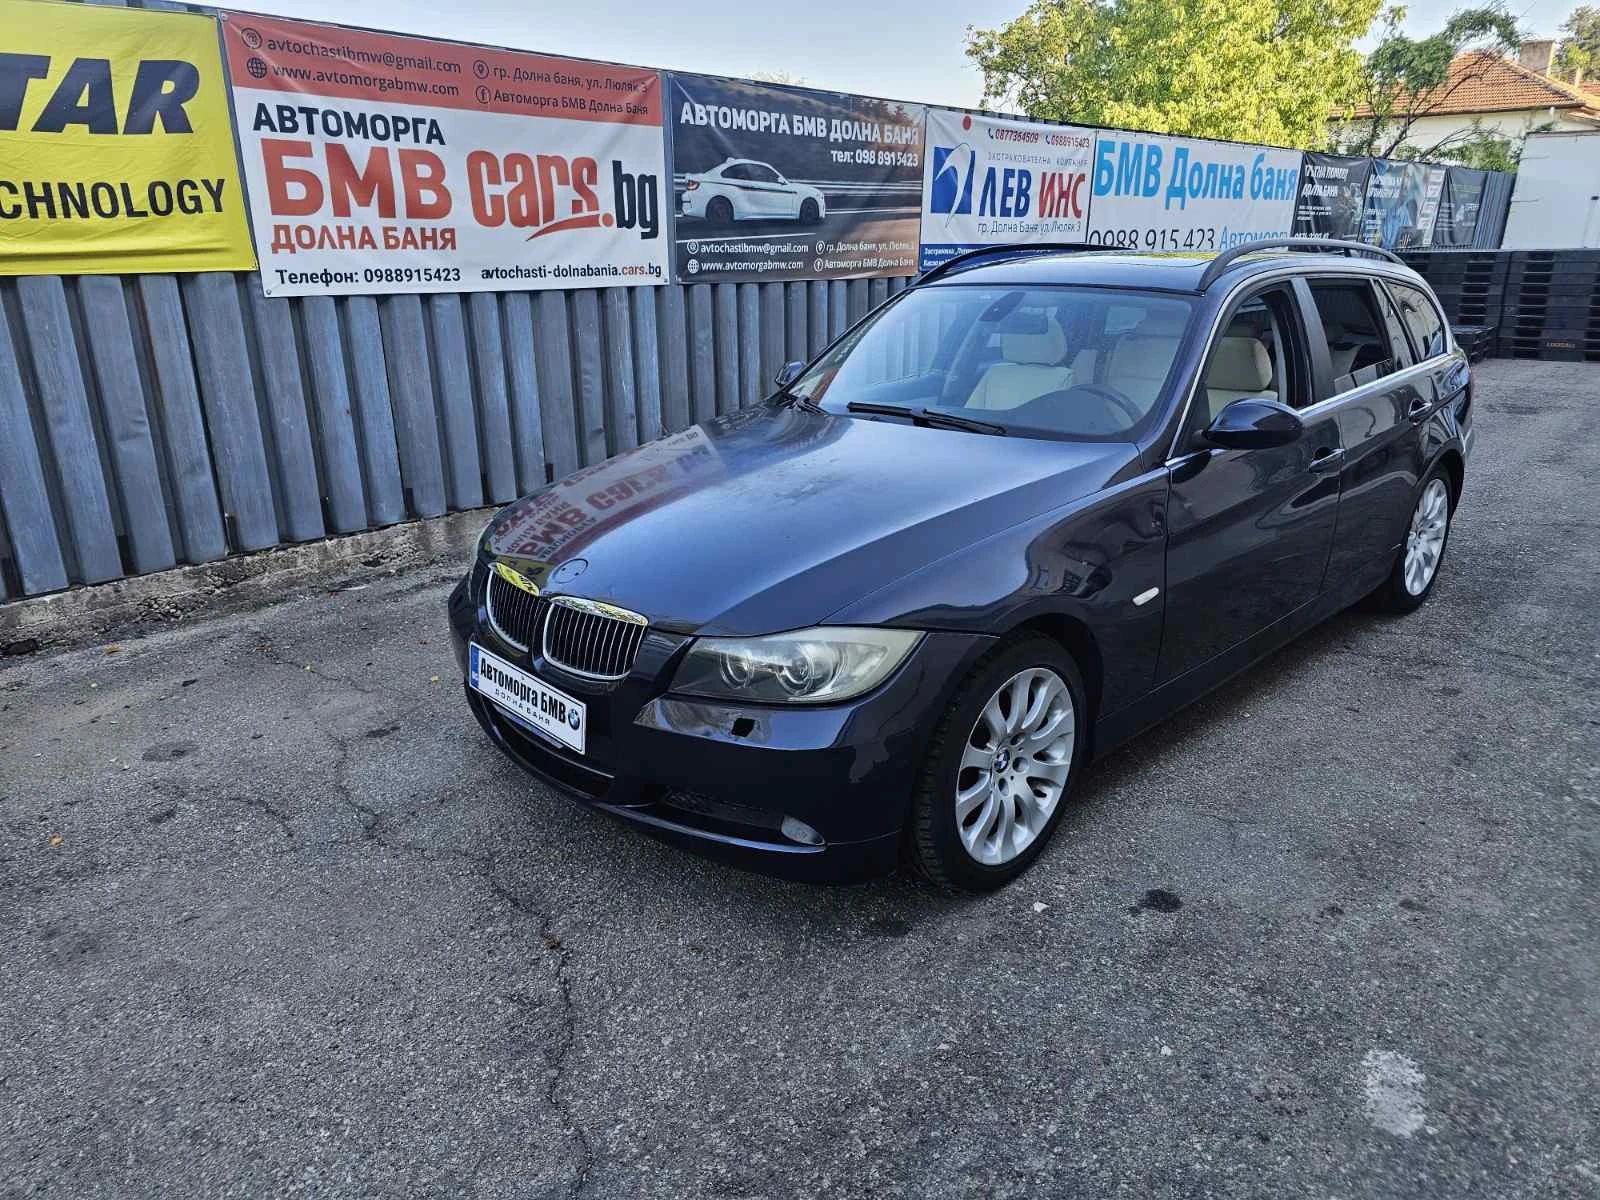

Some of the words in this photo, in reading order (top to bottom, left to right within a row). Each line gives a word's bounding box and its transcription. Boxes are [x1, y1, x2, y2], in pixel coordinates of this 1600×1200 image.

[272, 65, 459, 96] www.avtomorgabmw.com
[493, 67, 510, 80] гр.
[513, 67, 551, 82] Долна
[586, 78, 602, 90] ул.
[494, 90, 558, 108] Автоморга
[561, 96, 585, 110] БМВ
[589, 100, 623, 113] Долна
[253, 102, 446, 145] АВТОМОРГА
[680, 102, 790, 135] АВТОМОРГА
[792, 115, 827, 138] БМВ
[830, 119, 882, 143] ДОЛНА
[883, 124, 919, 145] БАНЯ
[855, 149, 876, 165] 098
[877, 150, 919, 167] 8915423
[261, 138, 452, 219] БМВ
[1093, 139, 1163, 198] БМВ
[1164, 146, 1245, 210] Долна
[1250, 153, 1298, 200] баня
[0, 178, 225, 219] CHNOLOGY
[978, 166, 1032, 217] ЛЕВ
[1038, 171, 1086, 218] ИНС
[271, 224, 377, 254] ДОЛНА
[382, 226, 457, 251] БАНЯ
[991, 220, 1017, 235] Долна
[1145, 229, 1179, 250] 915
[1183, 228, 1215, 250] 423
[701, 243, 809, 256] avtochastibmw@gmail.com
[481, 264, 662, 280] avtochasti-dolnabania.cars.bg
[701, 259, 804, 272] www.avtomorgabmw.com
[824, 259, 862, 270] Автоморга
[275, 269, 359, 287] Телефон:
[364, 268, 461, 283] 0988915423
[480, 657, 538, 708] Автоморга
[541, 691, 566, 724] БМВ
